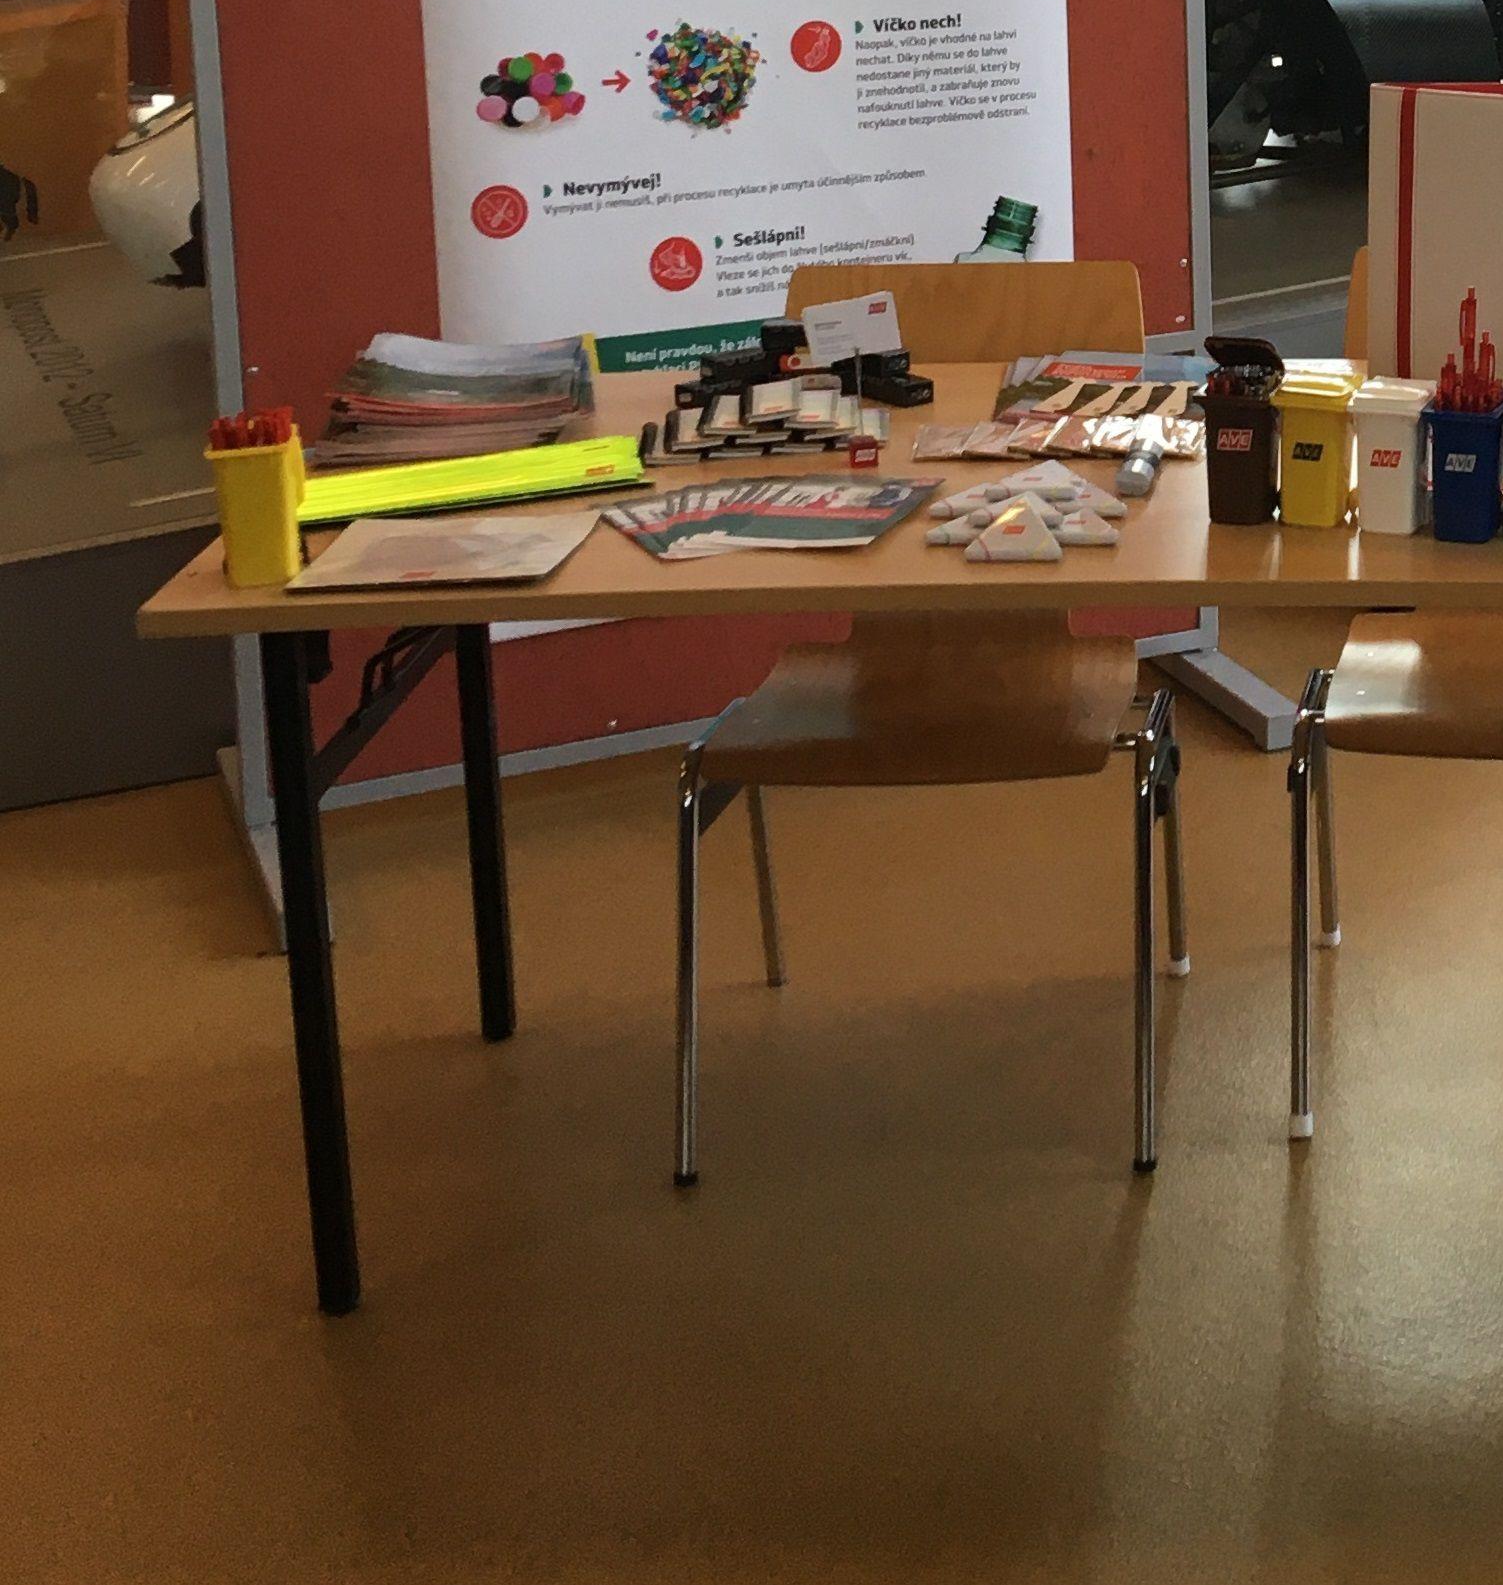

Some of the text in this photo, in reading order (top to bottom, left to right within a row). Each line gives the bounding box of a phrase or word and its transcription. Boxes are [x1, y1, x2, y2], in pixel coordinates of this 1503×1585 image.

[873, 14, 961, 32] Víčko nech!
[563, 174, 661, 196] Nevymývej!
[733, 226, 805, 246] Sešlápni!
[625, 338, 735, 363] Není pravdou, že
[1218, 430, 1252, 449] AVE
[1371, 451, 1401, 466] AVE
